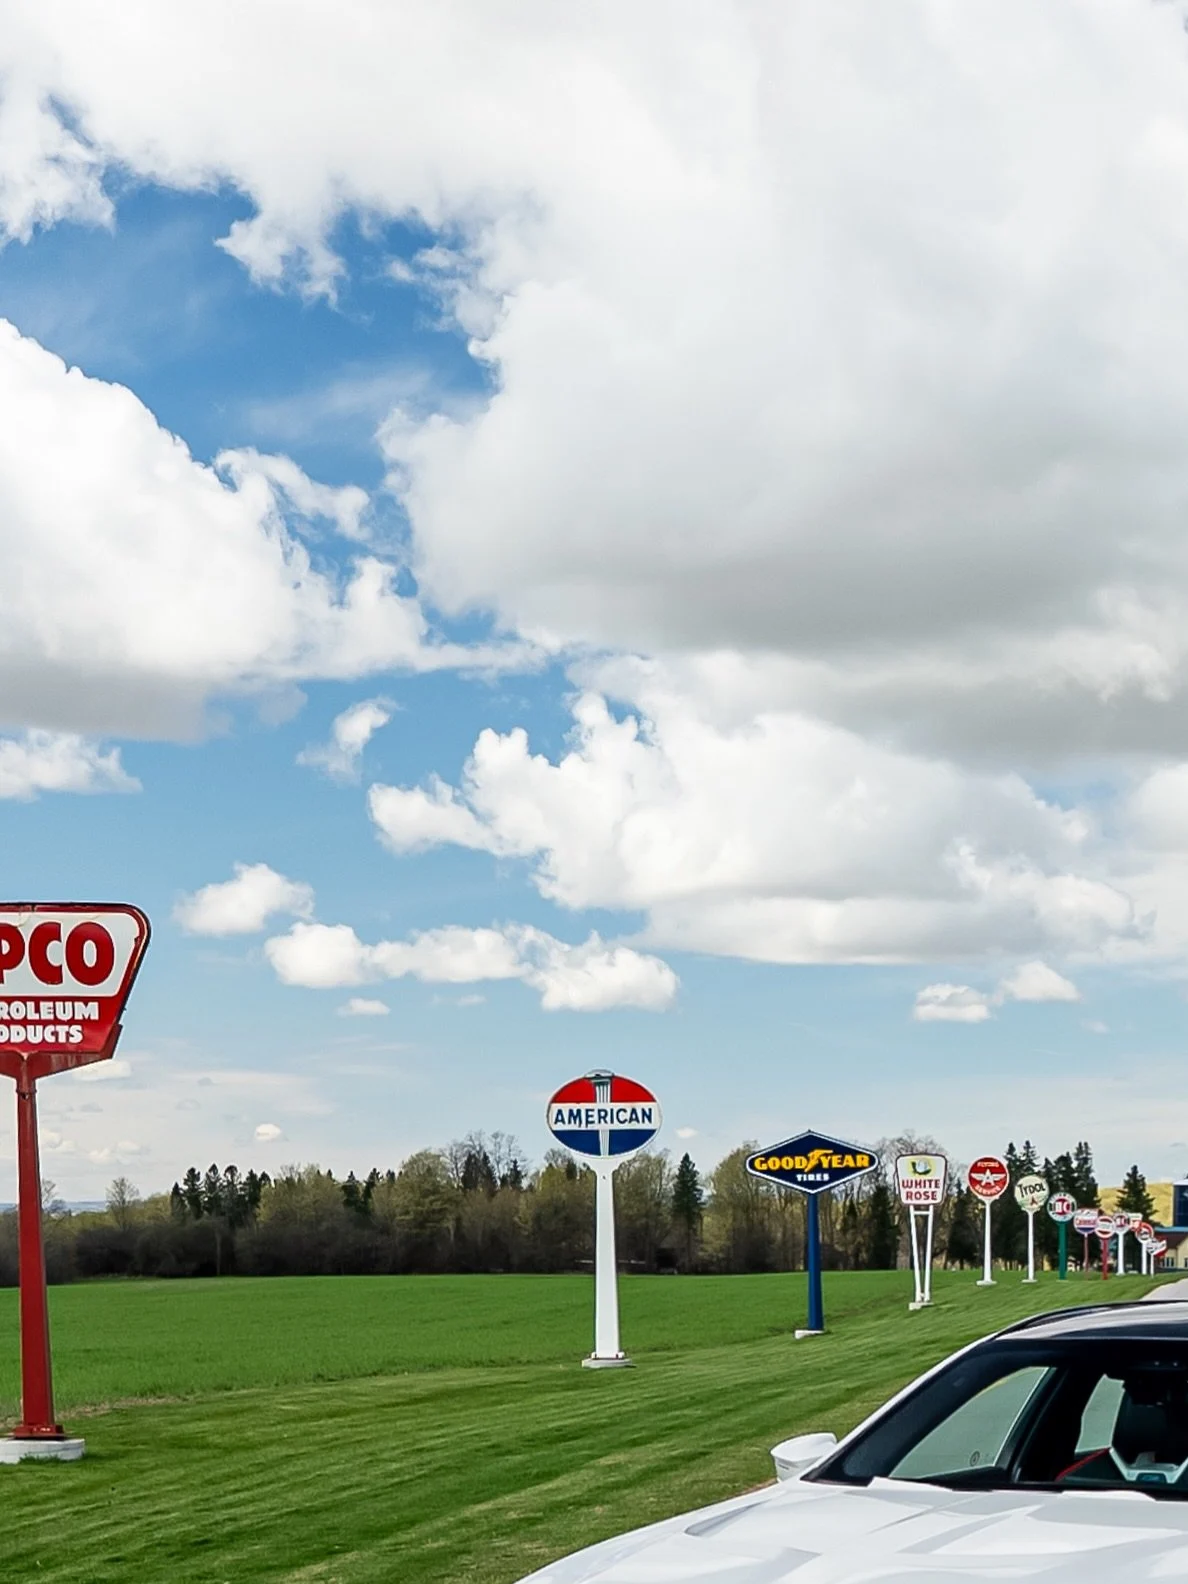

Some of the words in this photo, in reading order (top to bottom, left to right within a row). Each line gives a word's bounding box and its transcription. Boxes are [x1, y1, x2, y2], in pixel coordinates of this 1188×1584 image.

[554, 1107, 653, 1128] AMERICAN
[902, 1179, 941, 1189] WHITE
[906, 1191, 937, 1201] ROSE
